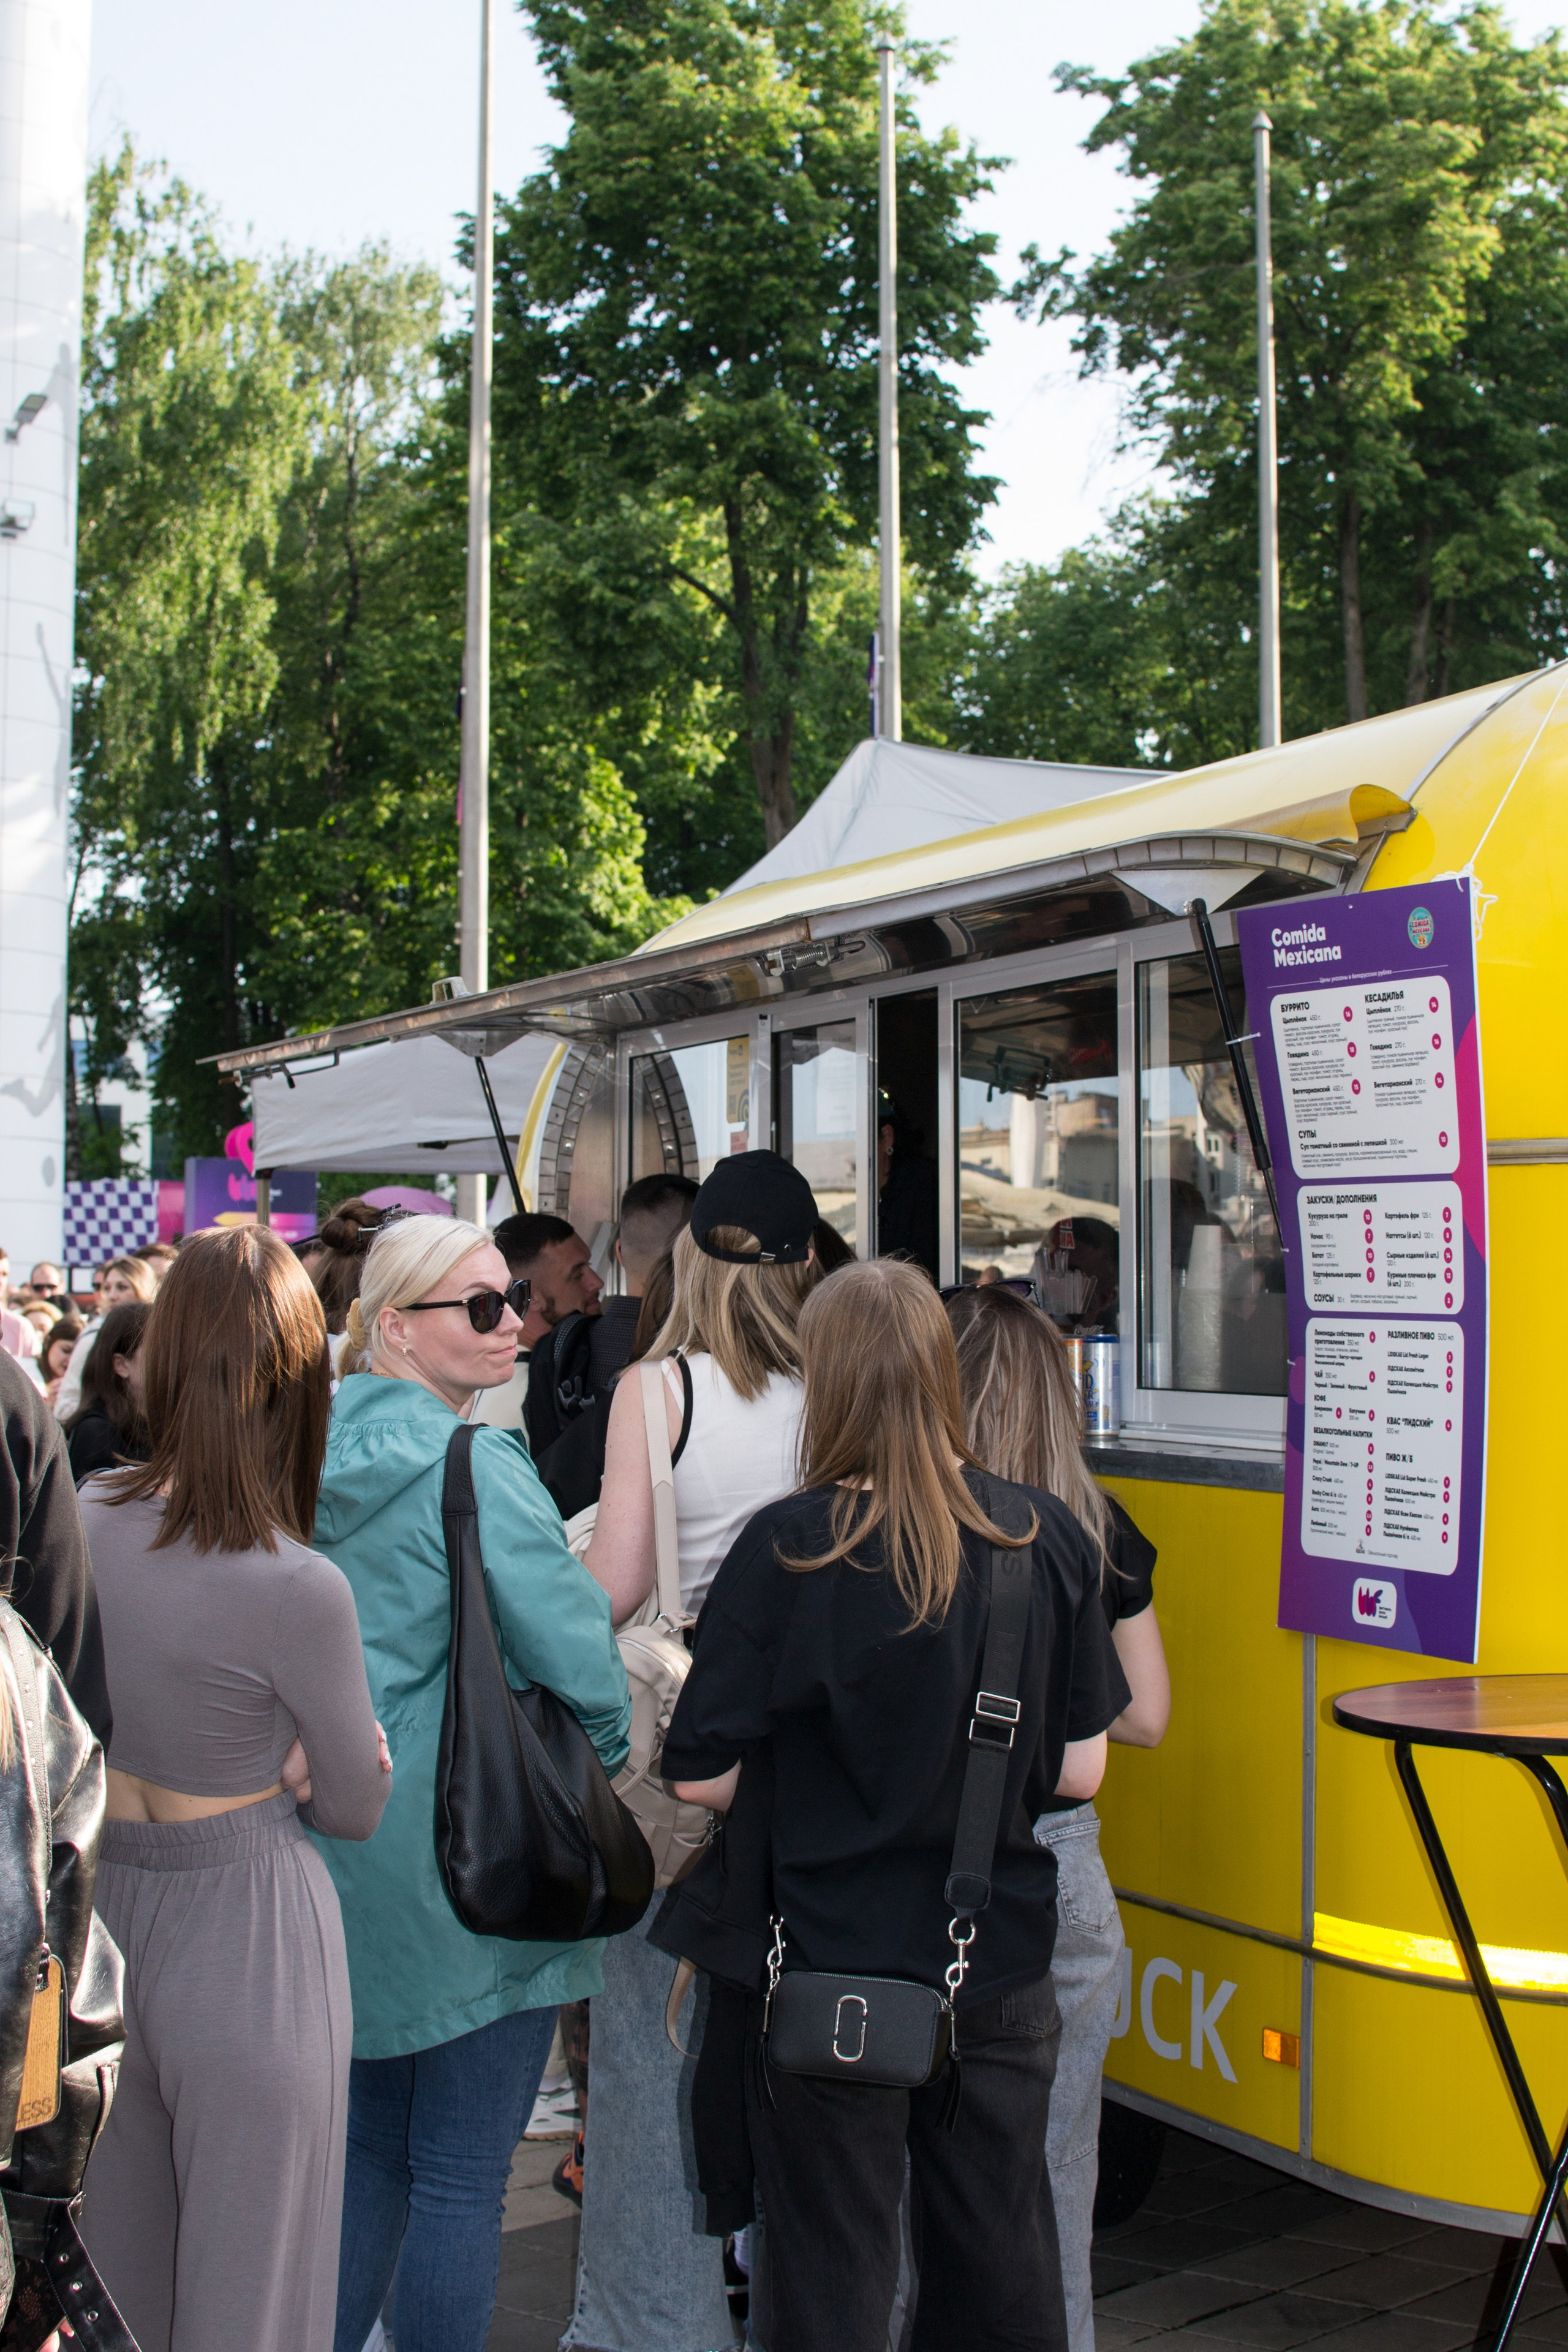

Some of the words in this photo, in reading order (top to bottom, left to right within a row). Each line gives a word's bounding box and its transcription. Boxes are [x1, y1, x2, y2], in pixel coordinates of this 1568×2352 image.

[1272, 924, 1326, 947] Comida
[1273, 944, 1341, 967] Mexicana
[1365, 990, 1404, 1003] КЕСАДИЛЬЯ
[1281, 1001, 1310, 1012] БУРРИТО
[1366, 1006, 1391, 1015] Цыплёнок
[1374, 1079, 1412, 1088] Вегетарианский
[1292, 1085, 1330, 1095] Вегетарианский
[1298, 1130, 1316, 1139] СУПЫ
[1300, 1142, 1309, 1151] Суп
[1387, 1330, 1419, 1340] РАЗЛИВНОЕ
[1314, 1427, 1351, 1436] БЕЗАЛКОГОЛЬНЫЕ
[1386, 1452, 1400, 1461] ПИВО
[18, 2097, 52, 2123] ESS
